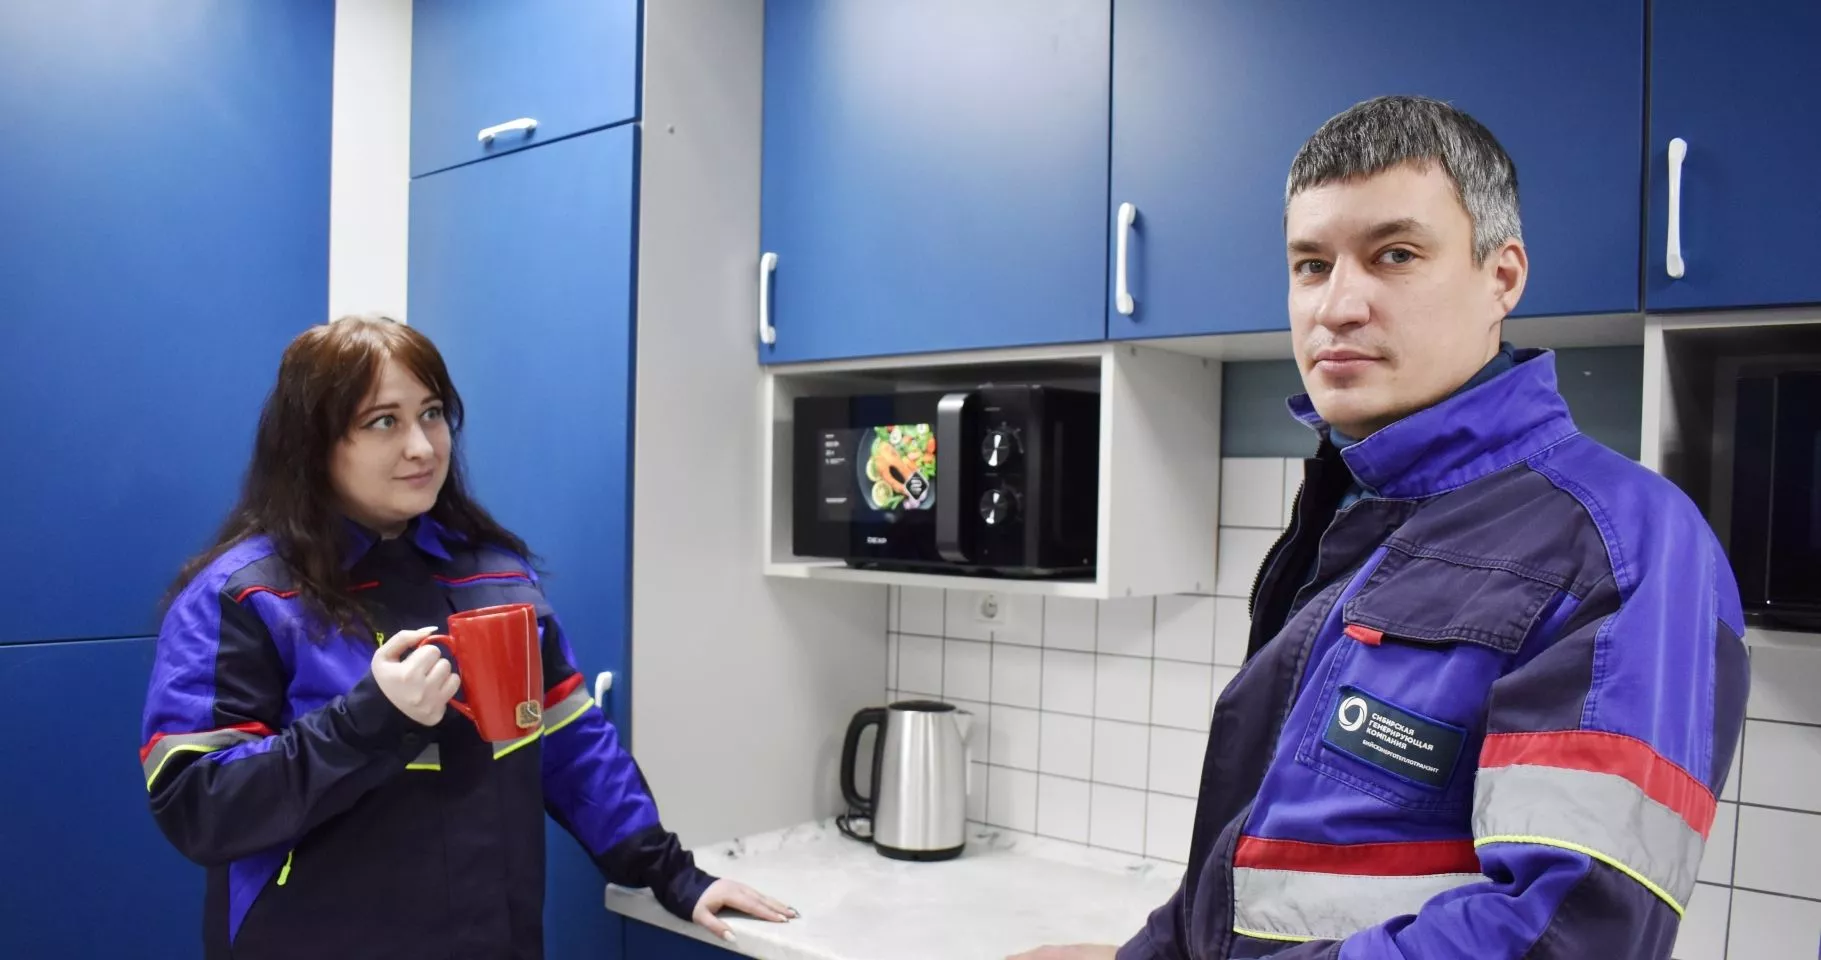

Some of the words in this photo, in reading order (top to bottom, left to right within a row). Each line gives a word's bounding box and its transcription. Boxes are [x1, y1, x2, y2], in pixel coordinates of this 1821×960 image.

[1368, 720, 1434, 751] ГЕНЕРИРУЮЩАЯ
[1371, 712, 1415, 736] СИБИРСКАЯ
[1366, 727, 1407, 750] КОМПАНИЯ
